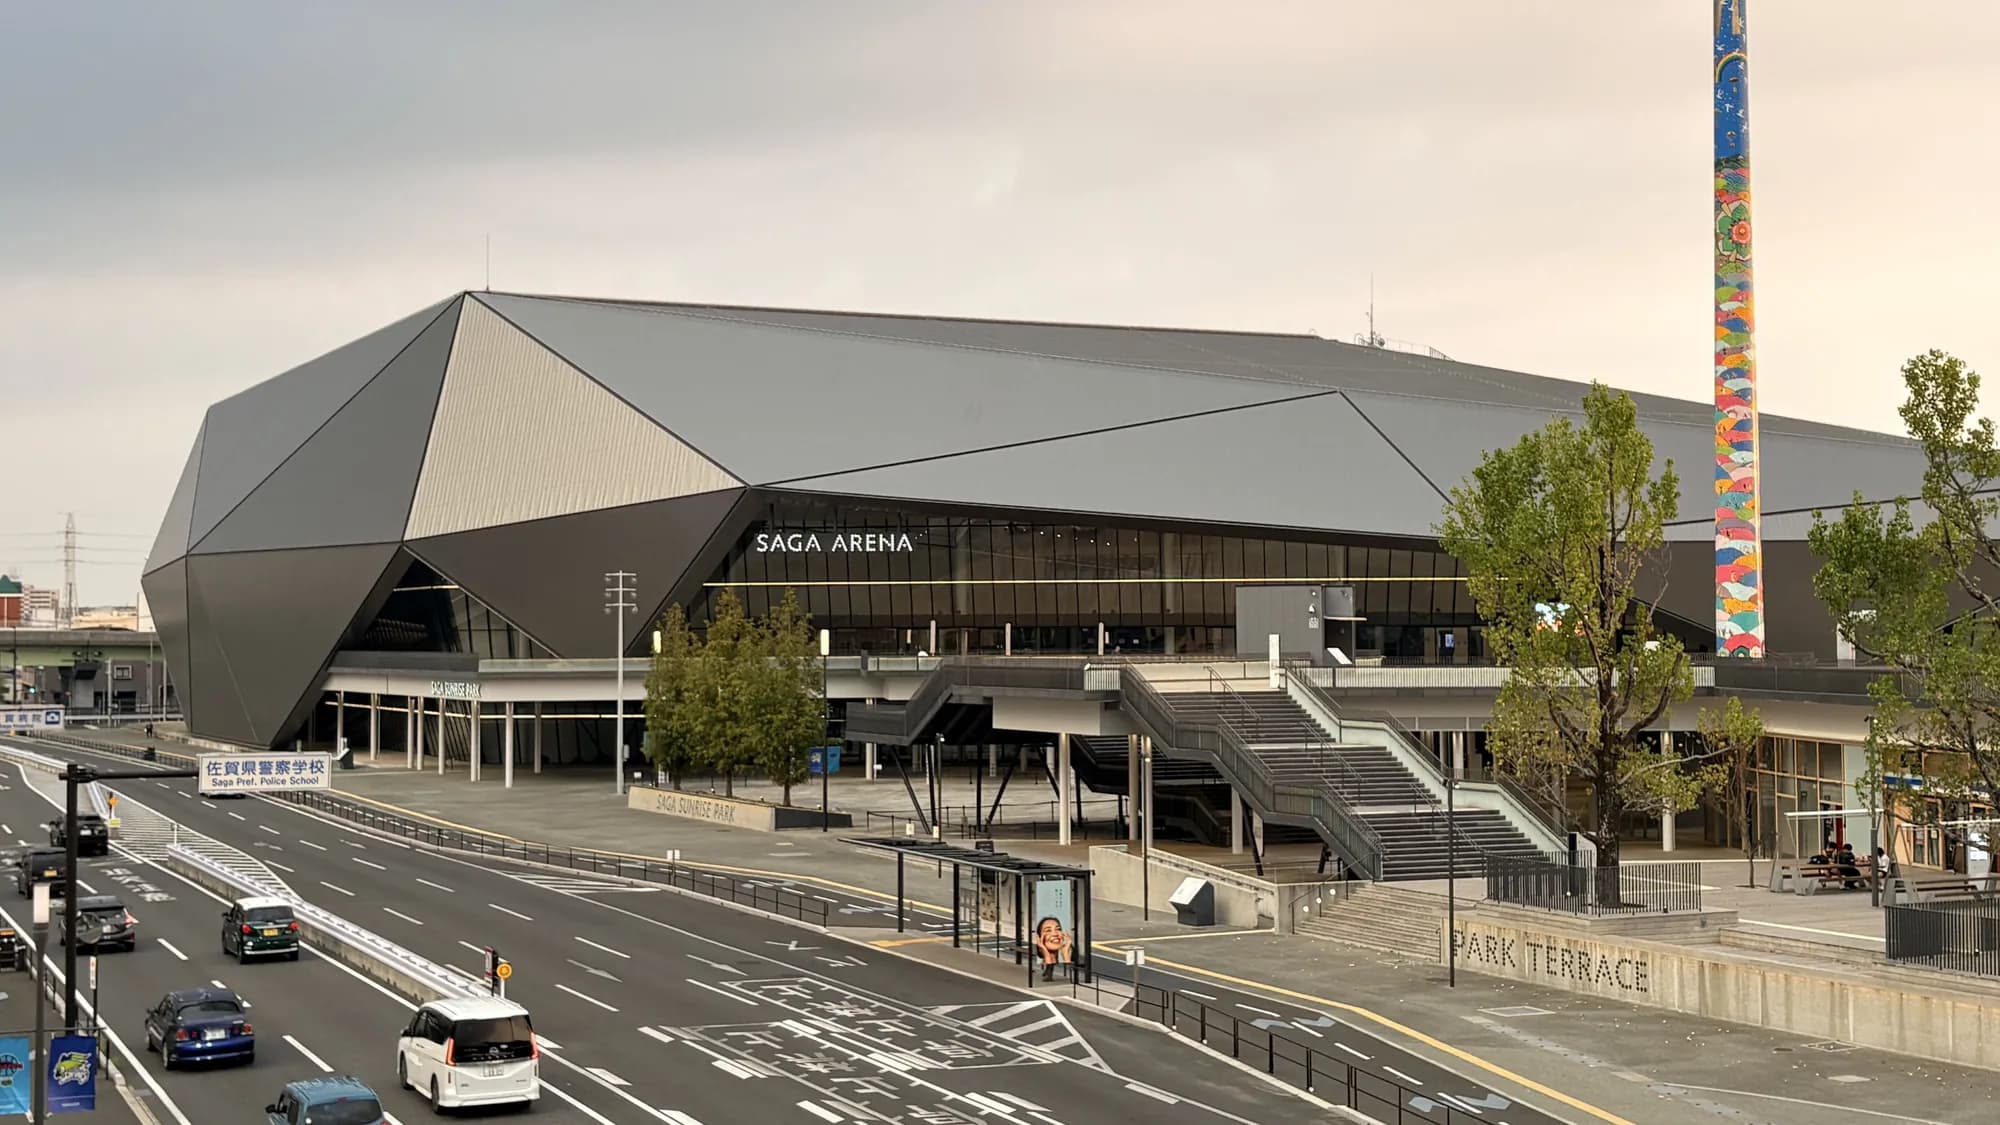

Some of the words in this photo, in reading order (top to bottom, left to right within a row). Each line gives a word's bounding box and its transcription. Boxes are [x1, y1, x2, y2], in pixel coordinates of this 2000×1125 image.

[756, 533, 822, 552] SAGA
[831, 533, 913, 552] ARENA
[207, 760, 325, 776] 佐賀県警察学校
[212, 778, 234, 788] Saga
[236, 777, 257, 786] Pref.
[260, 776, 287, 786] Police
[289, 775, 319, 785] School
[656, 793, 676, 812] SAGA
[679, 797, 711, 818] SUNRISE
[713, 802, 736, 822] PARK
[1453, 929, 1516, 968] PARK
[1526, 941, 1648, 992] TERRACE
[760, 983, 994, 1058] 停止禁止
